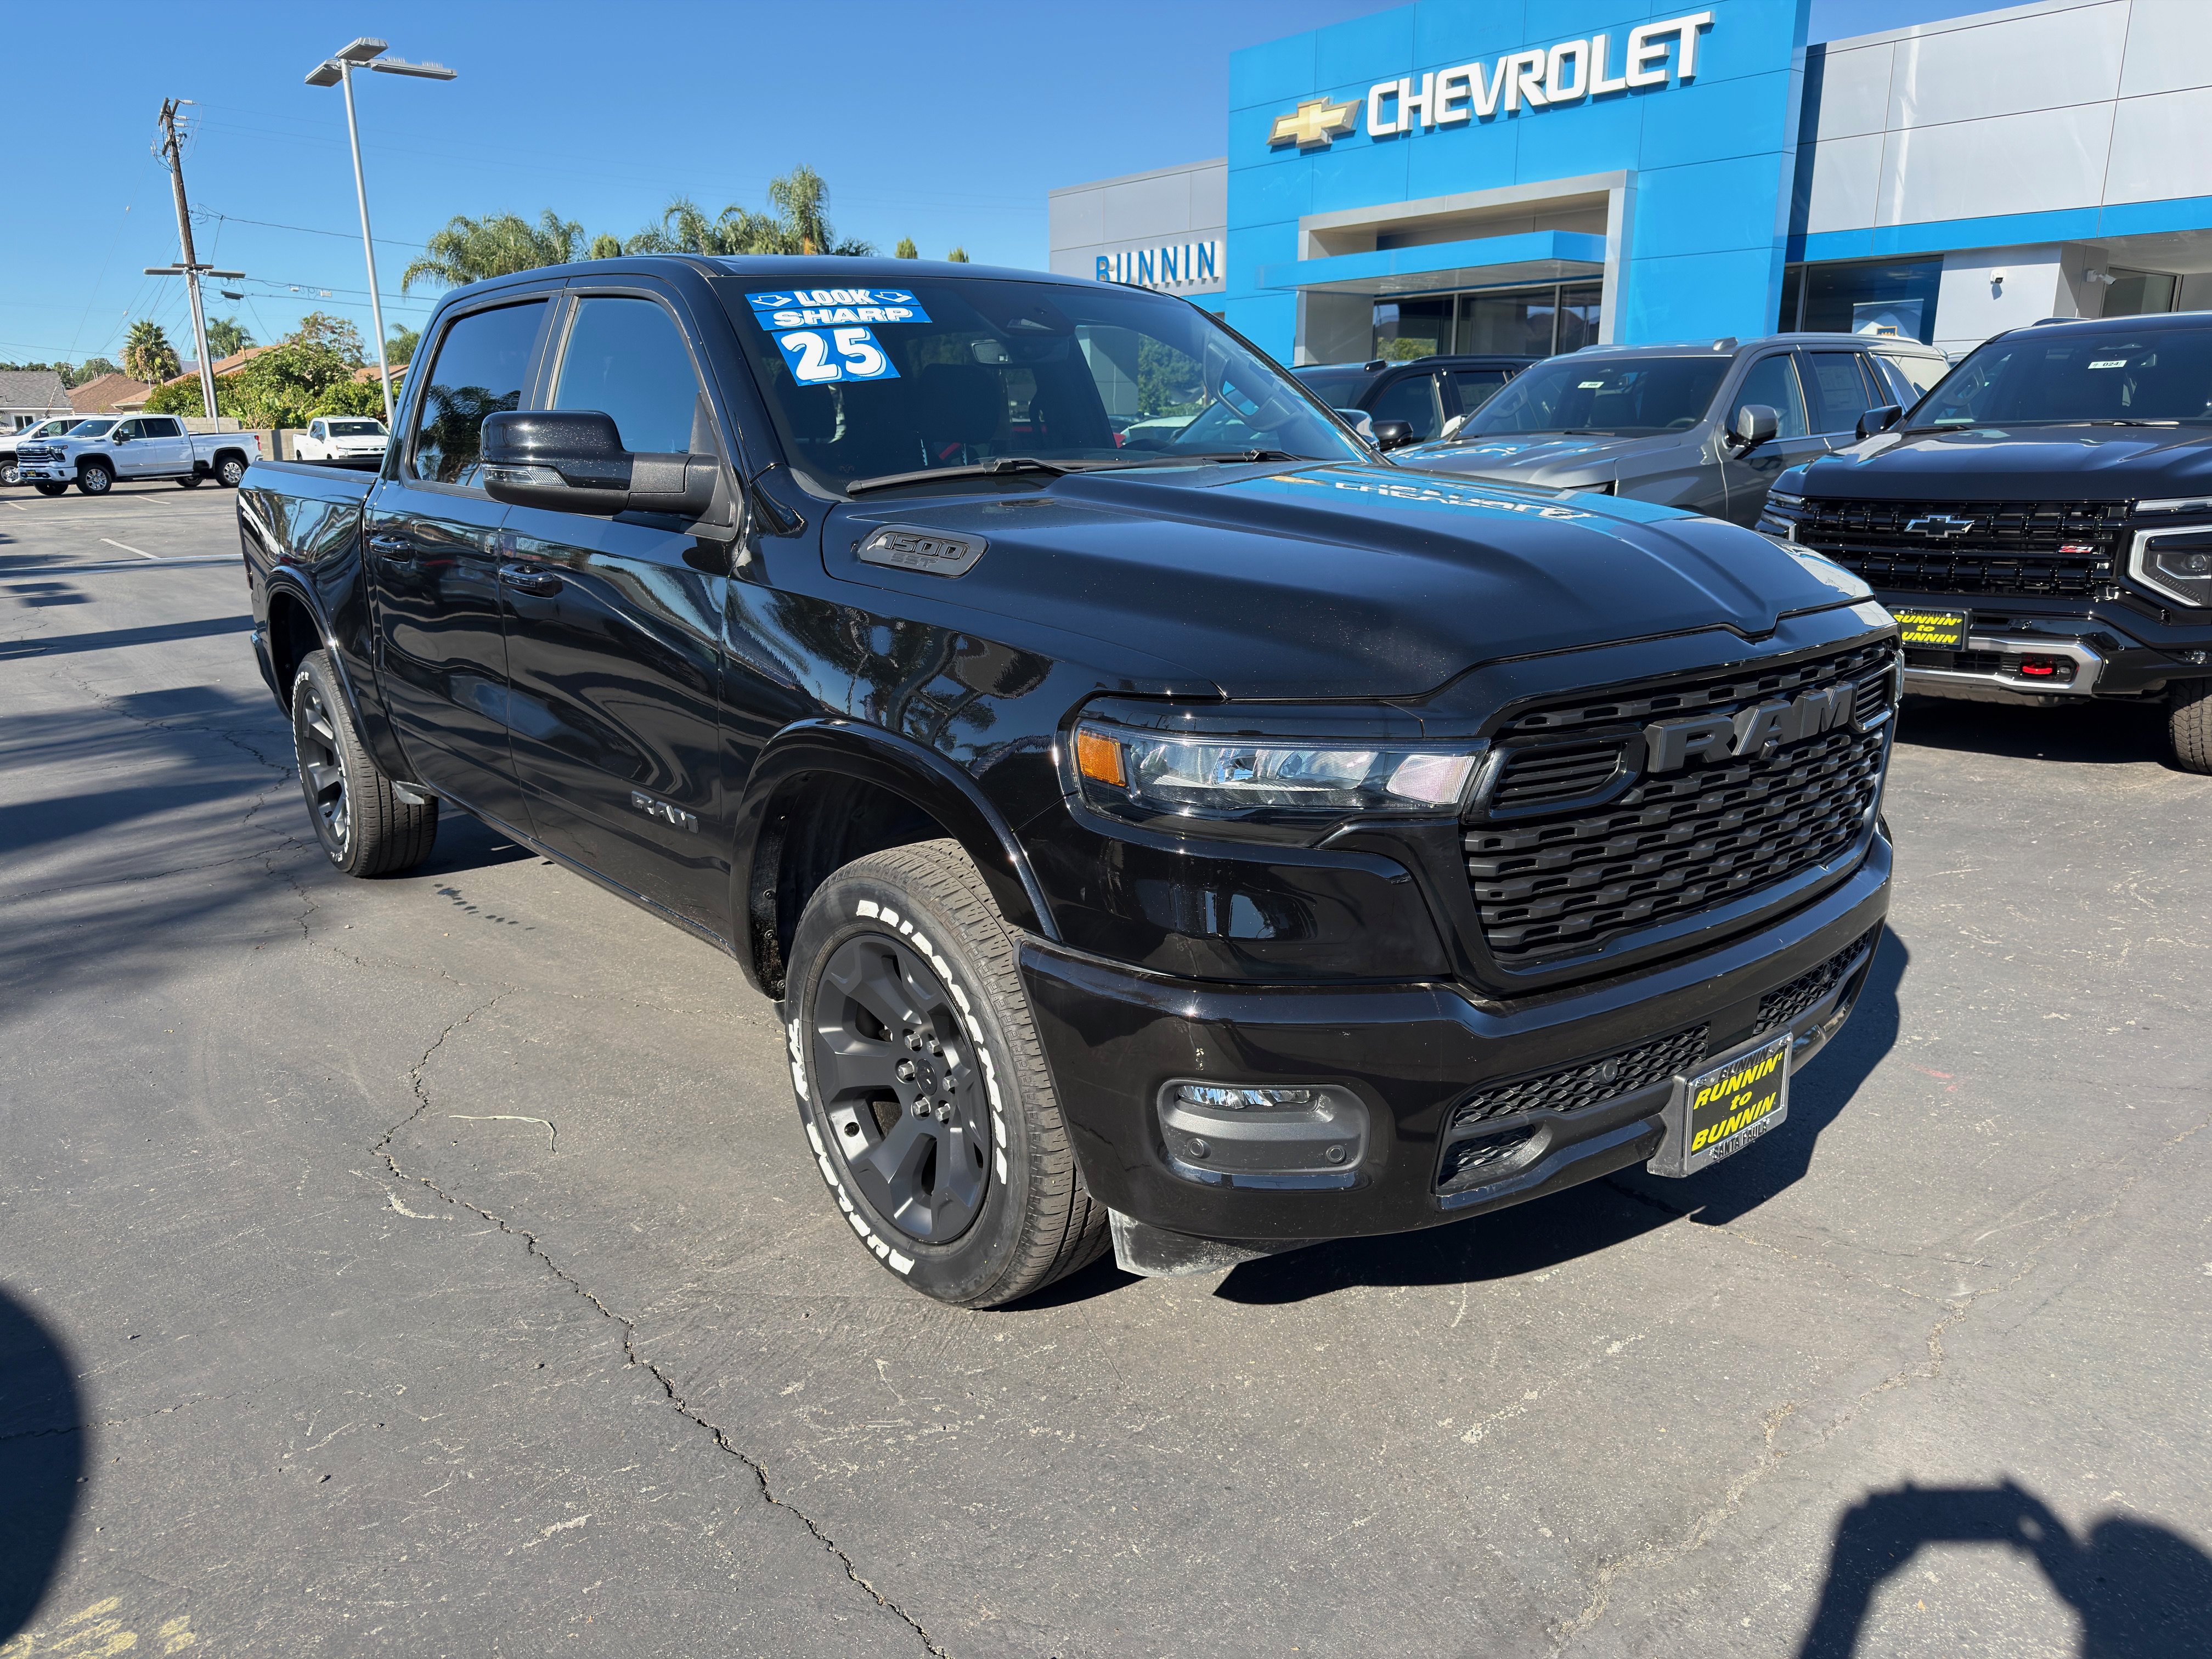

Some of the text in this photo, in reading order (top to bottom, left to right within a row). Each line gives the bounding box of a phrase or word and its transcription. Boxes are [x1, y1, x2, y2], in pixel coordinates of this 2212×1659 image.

[1367, 11, 1714, 136] CHEVROLET
[1096, 240, 1216, 285] BUNNIN
[793, 289, 879, 306] LOOK
[772, 307, 913, 326] SHARP
[781, 328, 887, 382] 25
[882, 533, 968, 560] 1500
[890, 552, 939, 567] SST
[1901, 632, 1957, 644] UNNIN
[1645, 680, 1853, 773] RAM
[1693, 1052, 1783, 1110] RUNNIN'
[1730, 1091, 1752, 1111] to
[1691, 1092, 1776, 1152] BUNNIN
